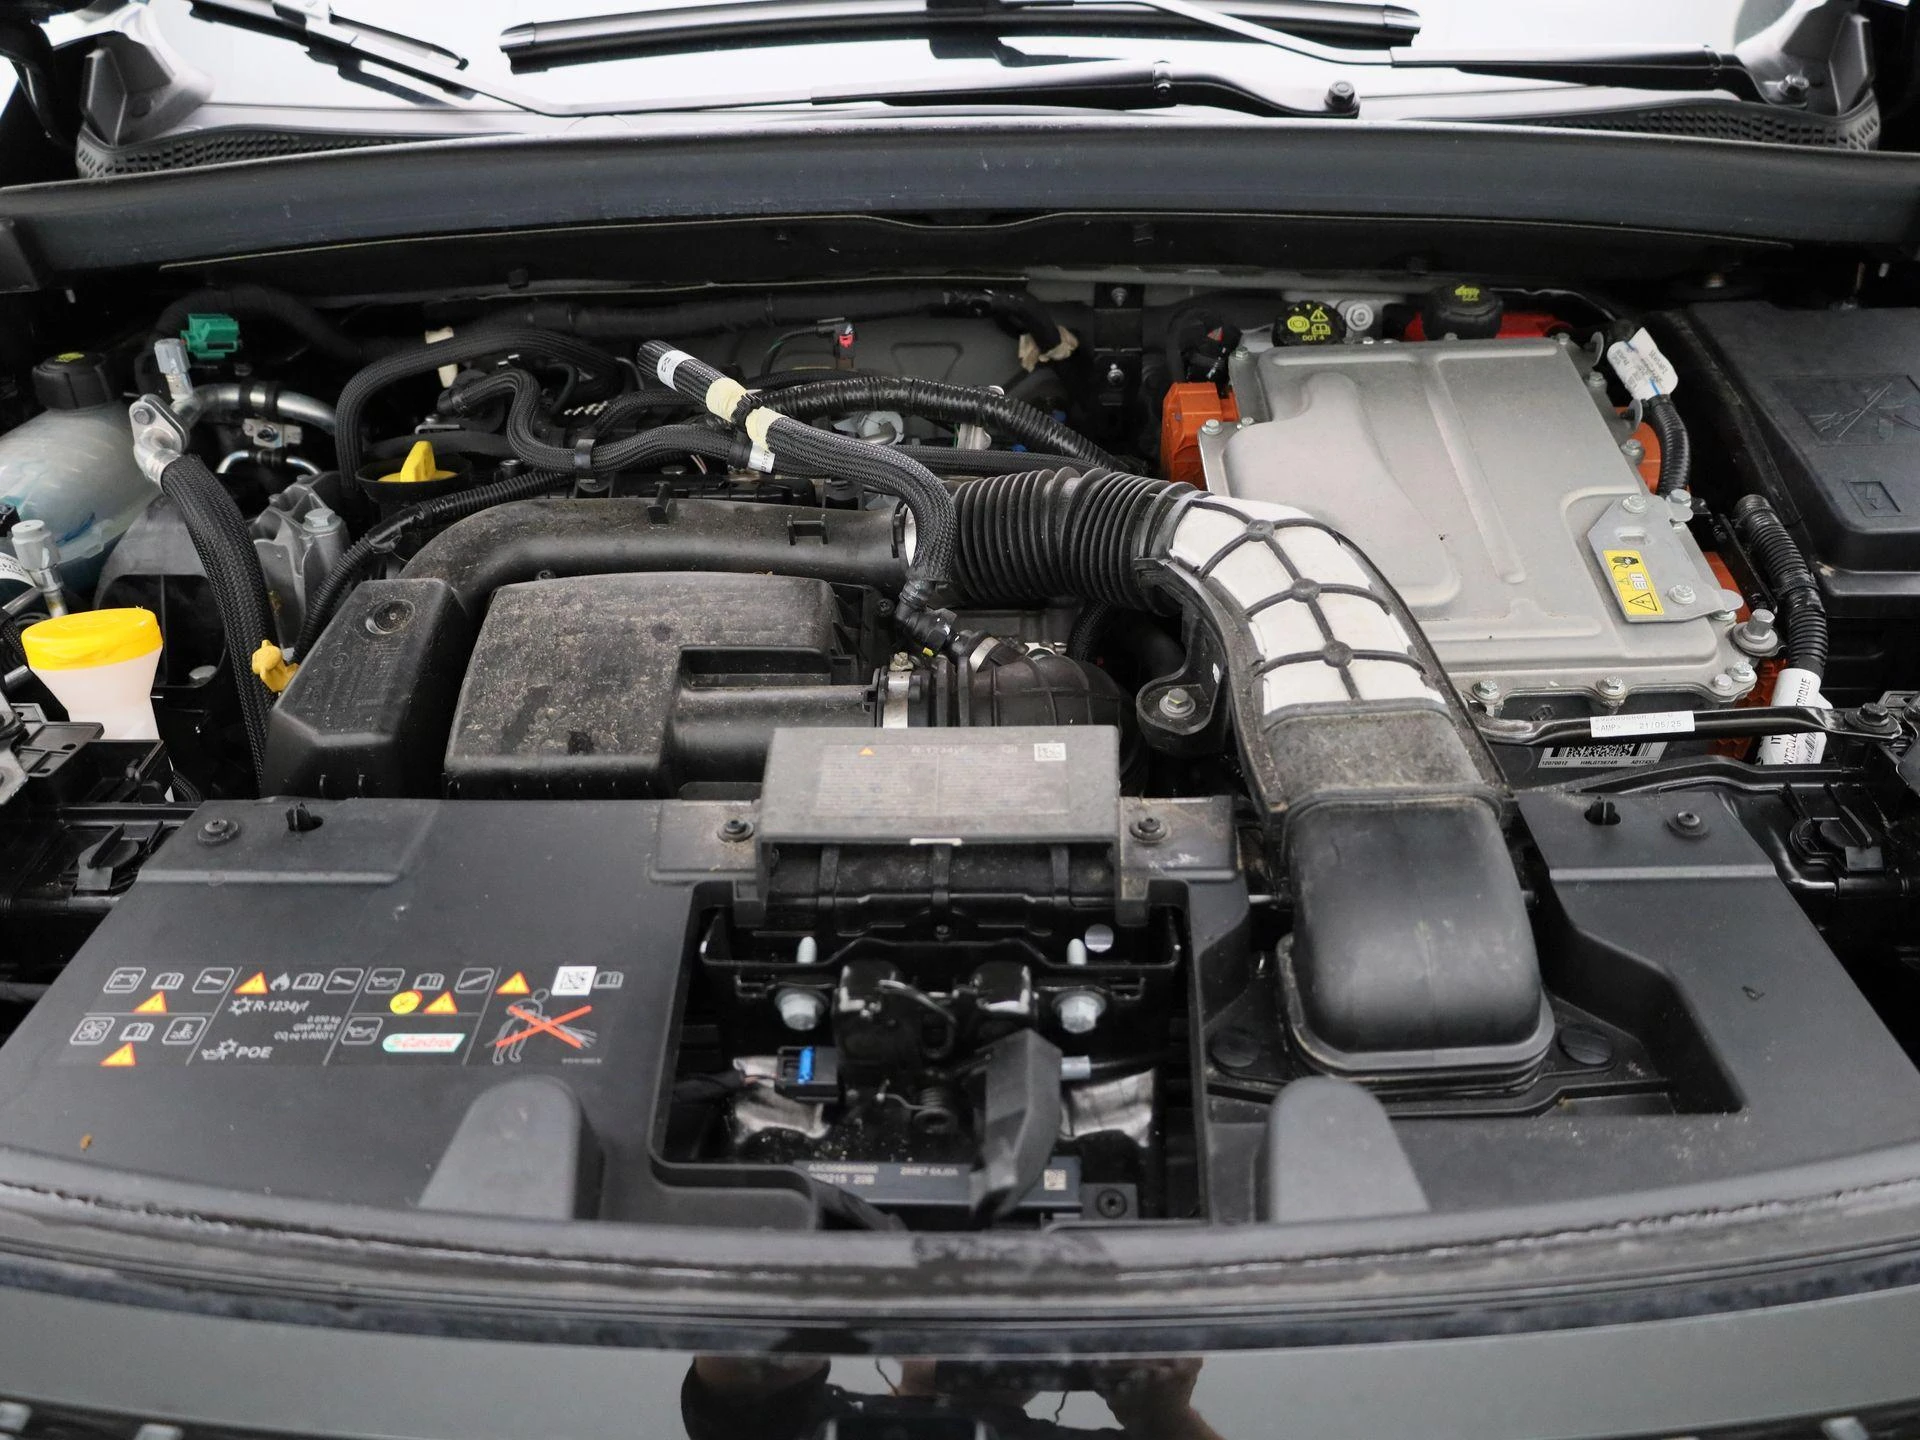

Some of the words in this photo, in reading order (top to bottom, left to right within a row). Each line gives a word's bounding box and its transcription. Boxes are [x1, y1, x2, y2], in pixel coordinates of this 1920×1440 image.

[1302, 334, 1318, 342] DOT
[252, 1000, 310, 1014] R-1234yf
[235, 1045, 273, 1058] POE
